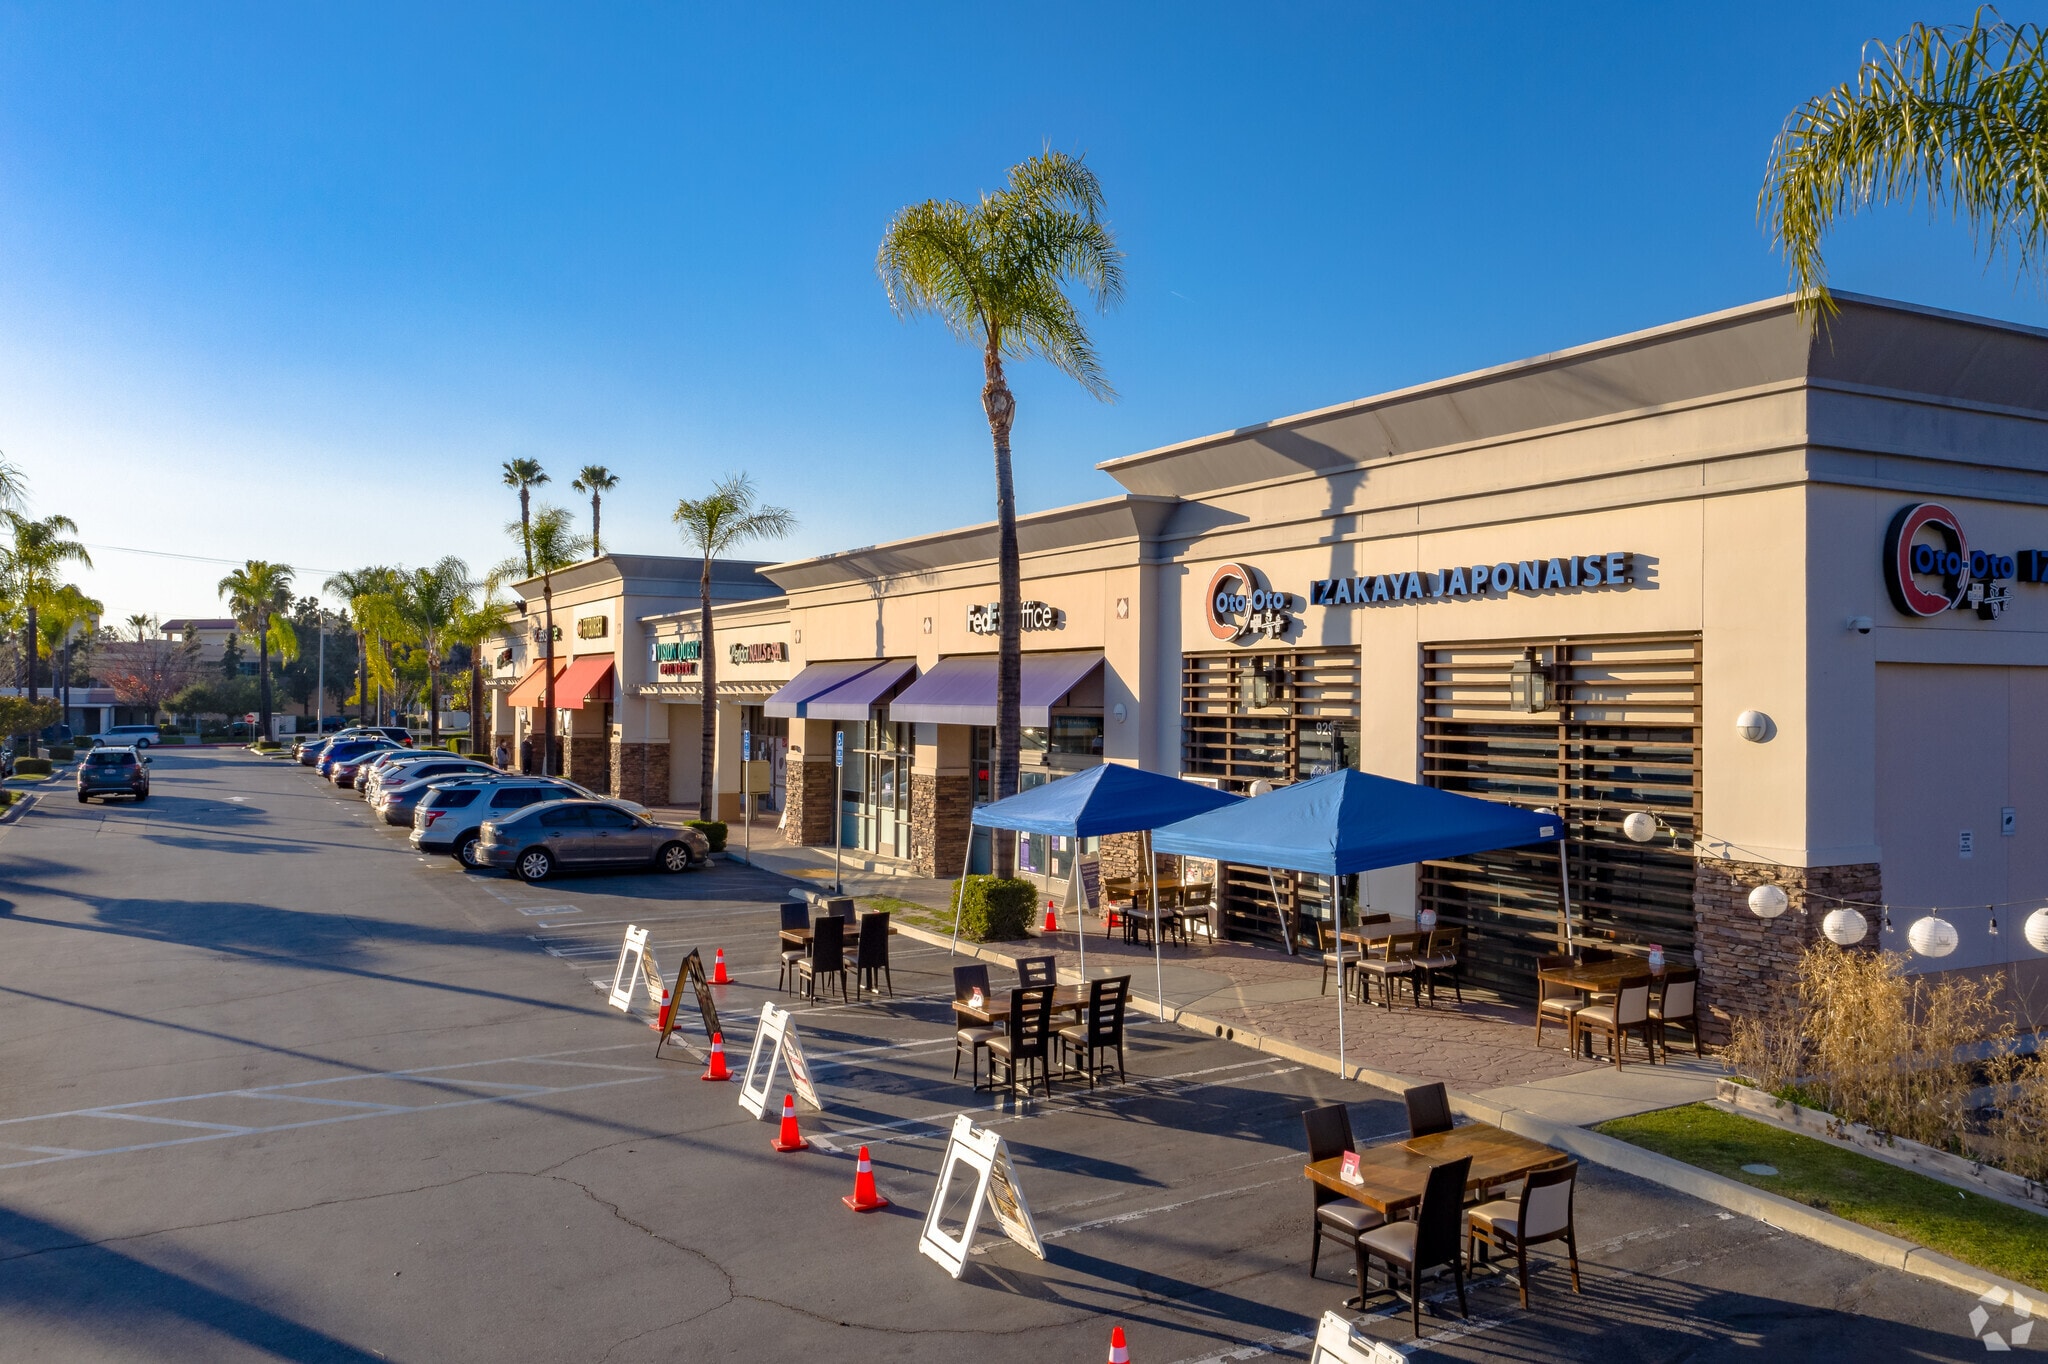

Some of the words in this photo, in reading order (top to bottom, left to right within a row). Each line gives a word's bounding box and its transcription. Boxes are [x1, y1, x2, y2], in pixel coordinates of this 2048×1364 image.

[1310, 571, 1424, 606] IZAKAYA
[1433, 552, 1626, 597] JAPONAISE
[1020, 600, 1052, 628] ffice
[657, 643, 677, 661] VISION
[677, 641, 699, 662] QUEST
[749, 643, 766, 661] NAILS
